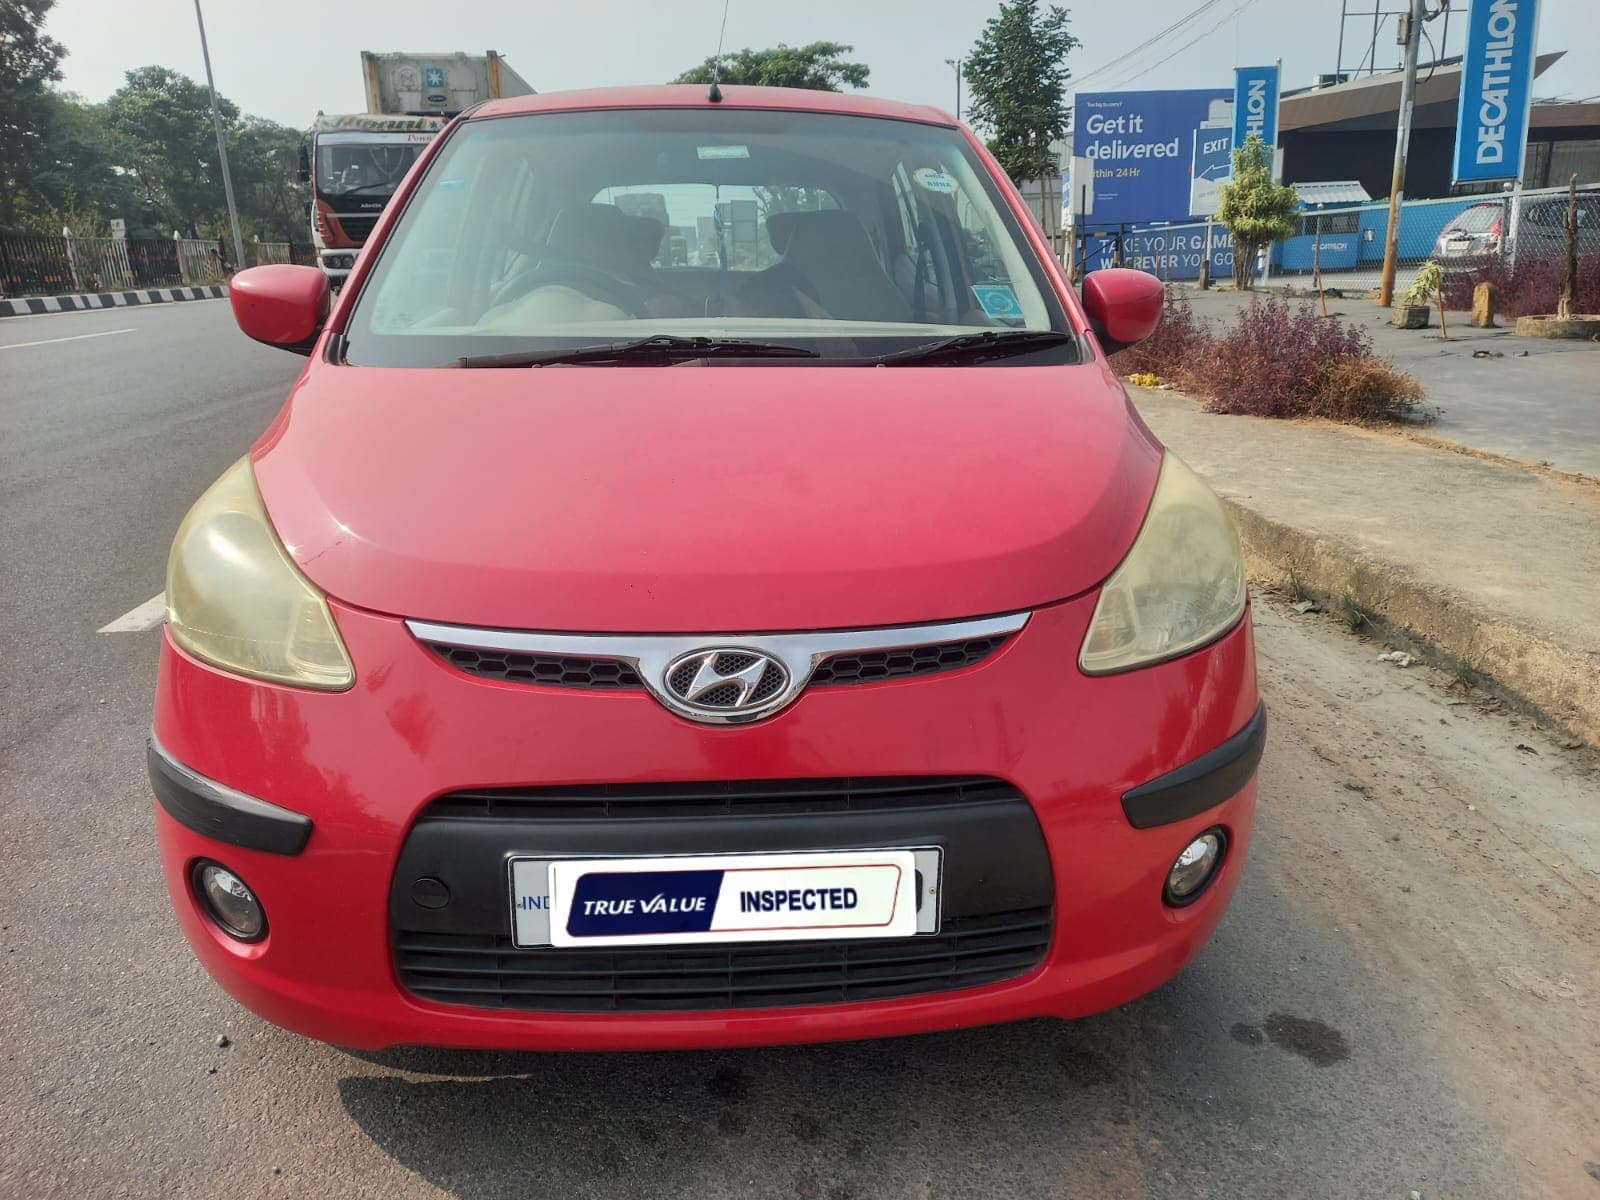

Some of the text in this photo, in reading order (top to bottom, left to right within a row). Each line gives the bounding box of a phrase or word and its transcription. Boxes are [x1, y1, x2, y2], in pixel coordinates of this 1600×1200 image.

[1086, 113, 1143, 135] Get it
[1085, 137, 1179, 160] delivered
[1203, 137, 1229, 154] EXIT
[1144, 236, 1186, 252] YOUR
[1100, 252, 1234, 270] WEREVER YO GO
